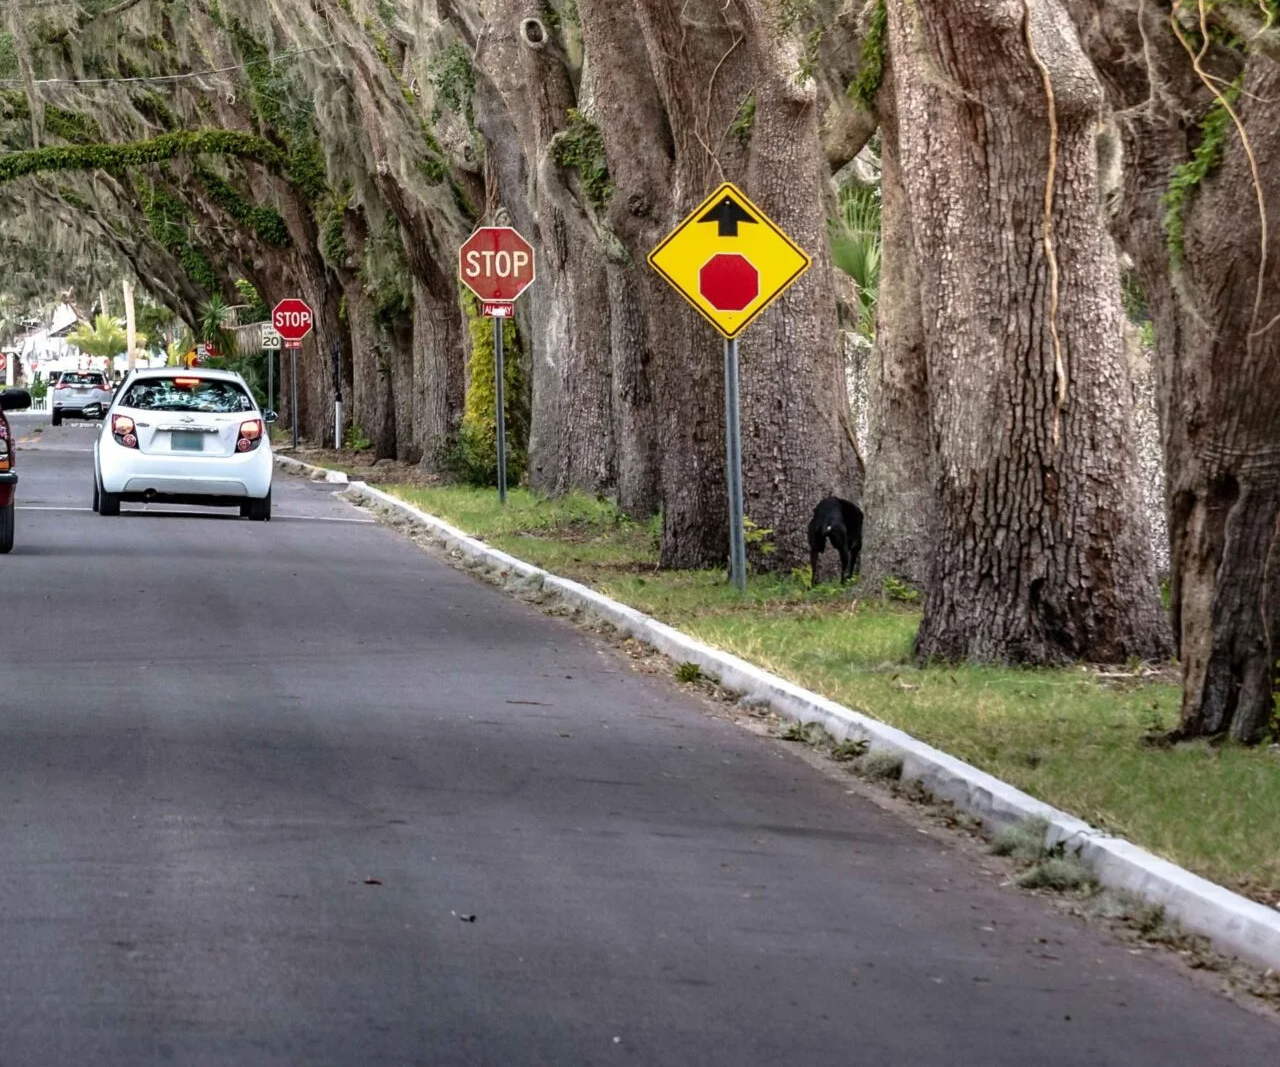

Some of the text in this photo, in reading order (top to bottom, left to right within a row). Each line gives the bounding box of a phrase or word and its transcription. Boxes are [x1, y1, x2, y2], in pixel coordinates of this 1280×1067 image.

[466, 250, 528, 277] STOP
[276, 312, 309, 326] STOP
[263, 336, 279, 346] 20
